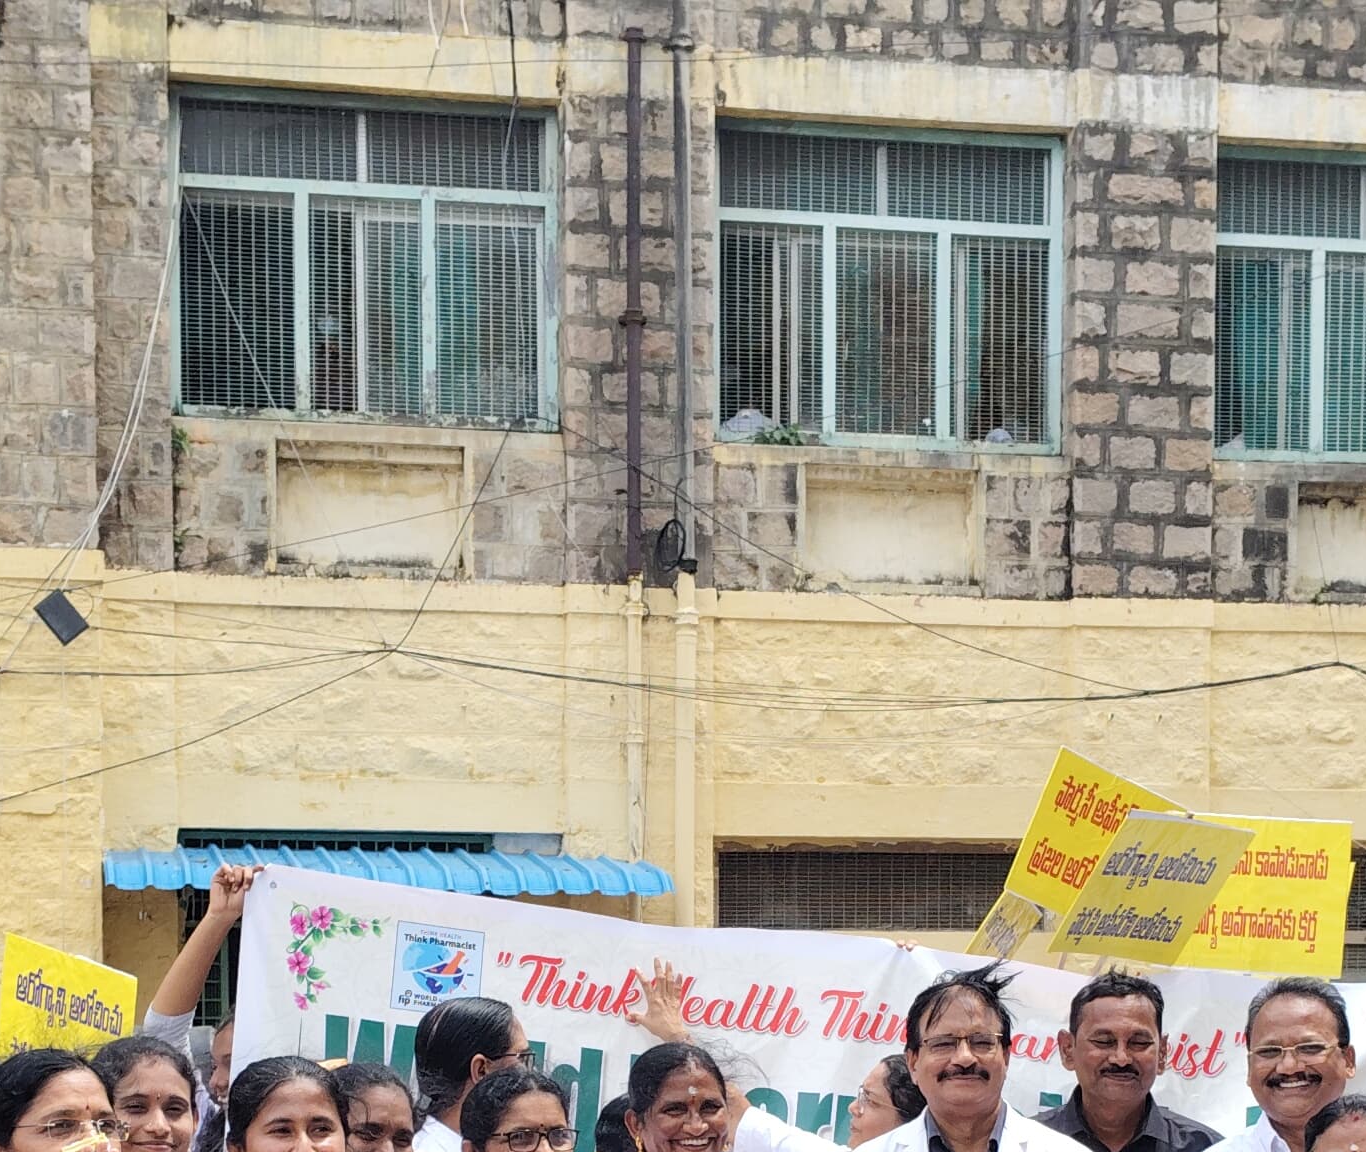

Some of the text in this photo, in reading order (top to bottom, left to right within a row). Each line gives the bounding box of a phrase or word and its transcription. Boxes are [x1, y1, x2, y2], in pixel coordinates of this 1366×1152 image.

[1026, 837, 1066, 879] ప్రజల
[1255, 845, 1329, 880] కాపాడువాడు
[1221, 906, 1296, 940] అవగాహనకు
[404, 933, 477, 951] Think Pharmacist
